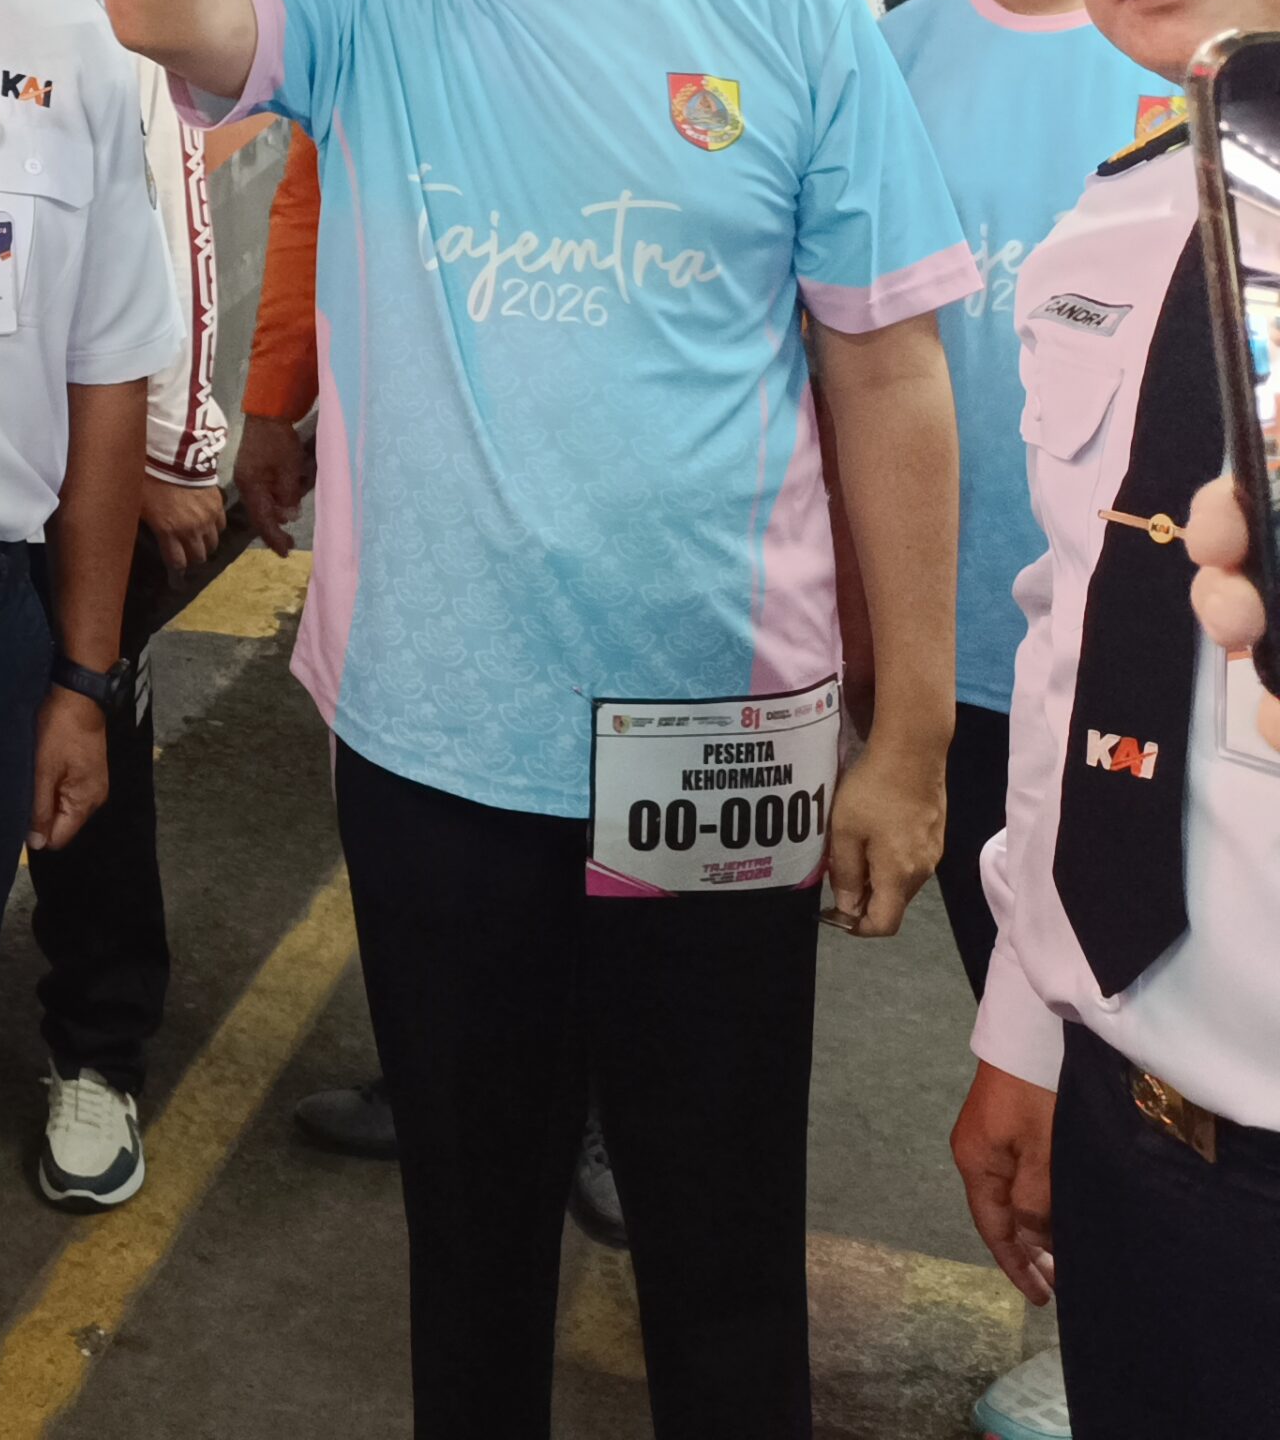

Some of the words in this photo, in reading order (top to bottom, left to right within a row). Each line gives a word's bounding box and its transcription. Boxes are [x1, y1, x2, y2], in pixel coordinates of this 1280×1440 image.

[1, 70, 53, 109] KAI
[500, 278, 609, 327] 2026
[703, 741, 775, 765] PESERTA
[1086, 728, 1159, 779] KAI
[682, 763, 793, 791] KEHORMATAN
[628, 783, 826, 851] 00-0001
